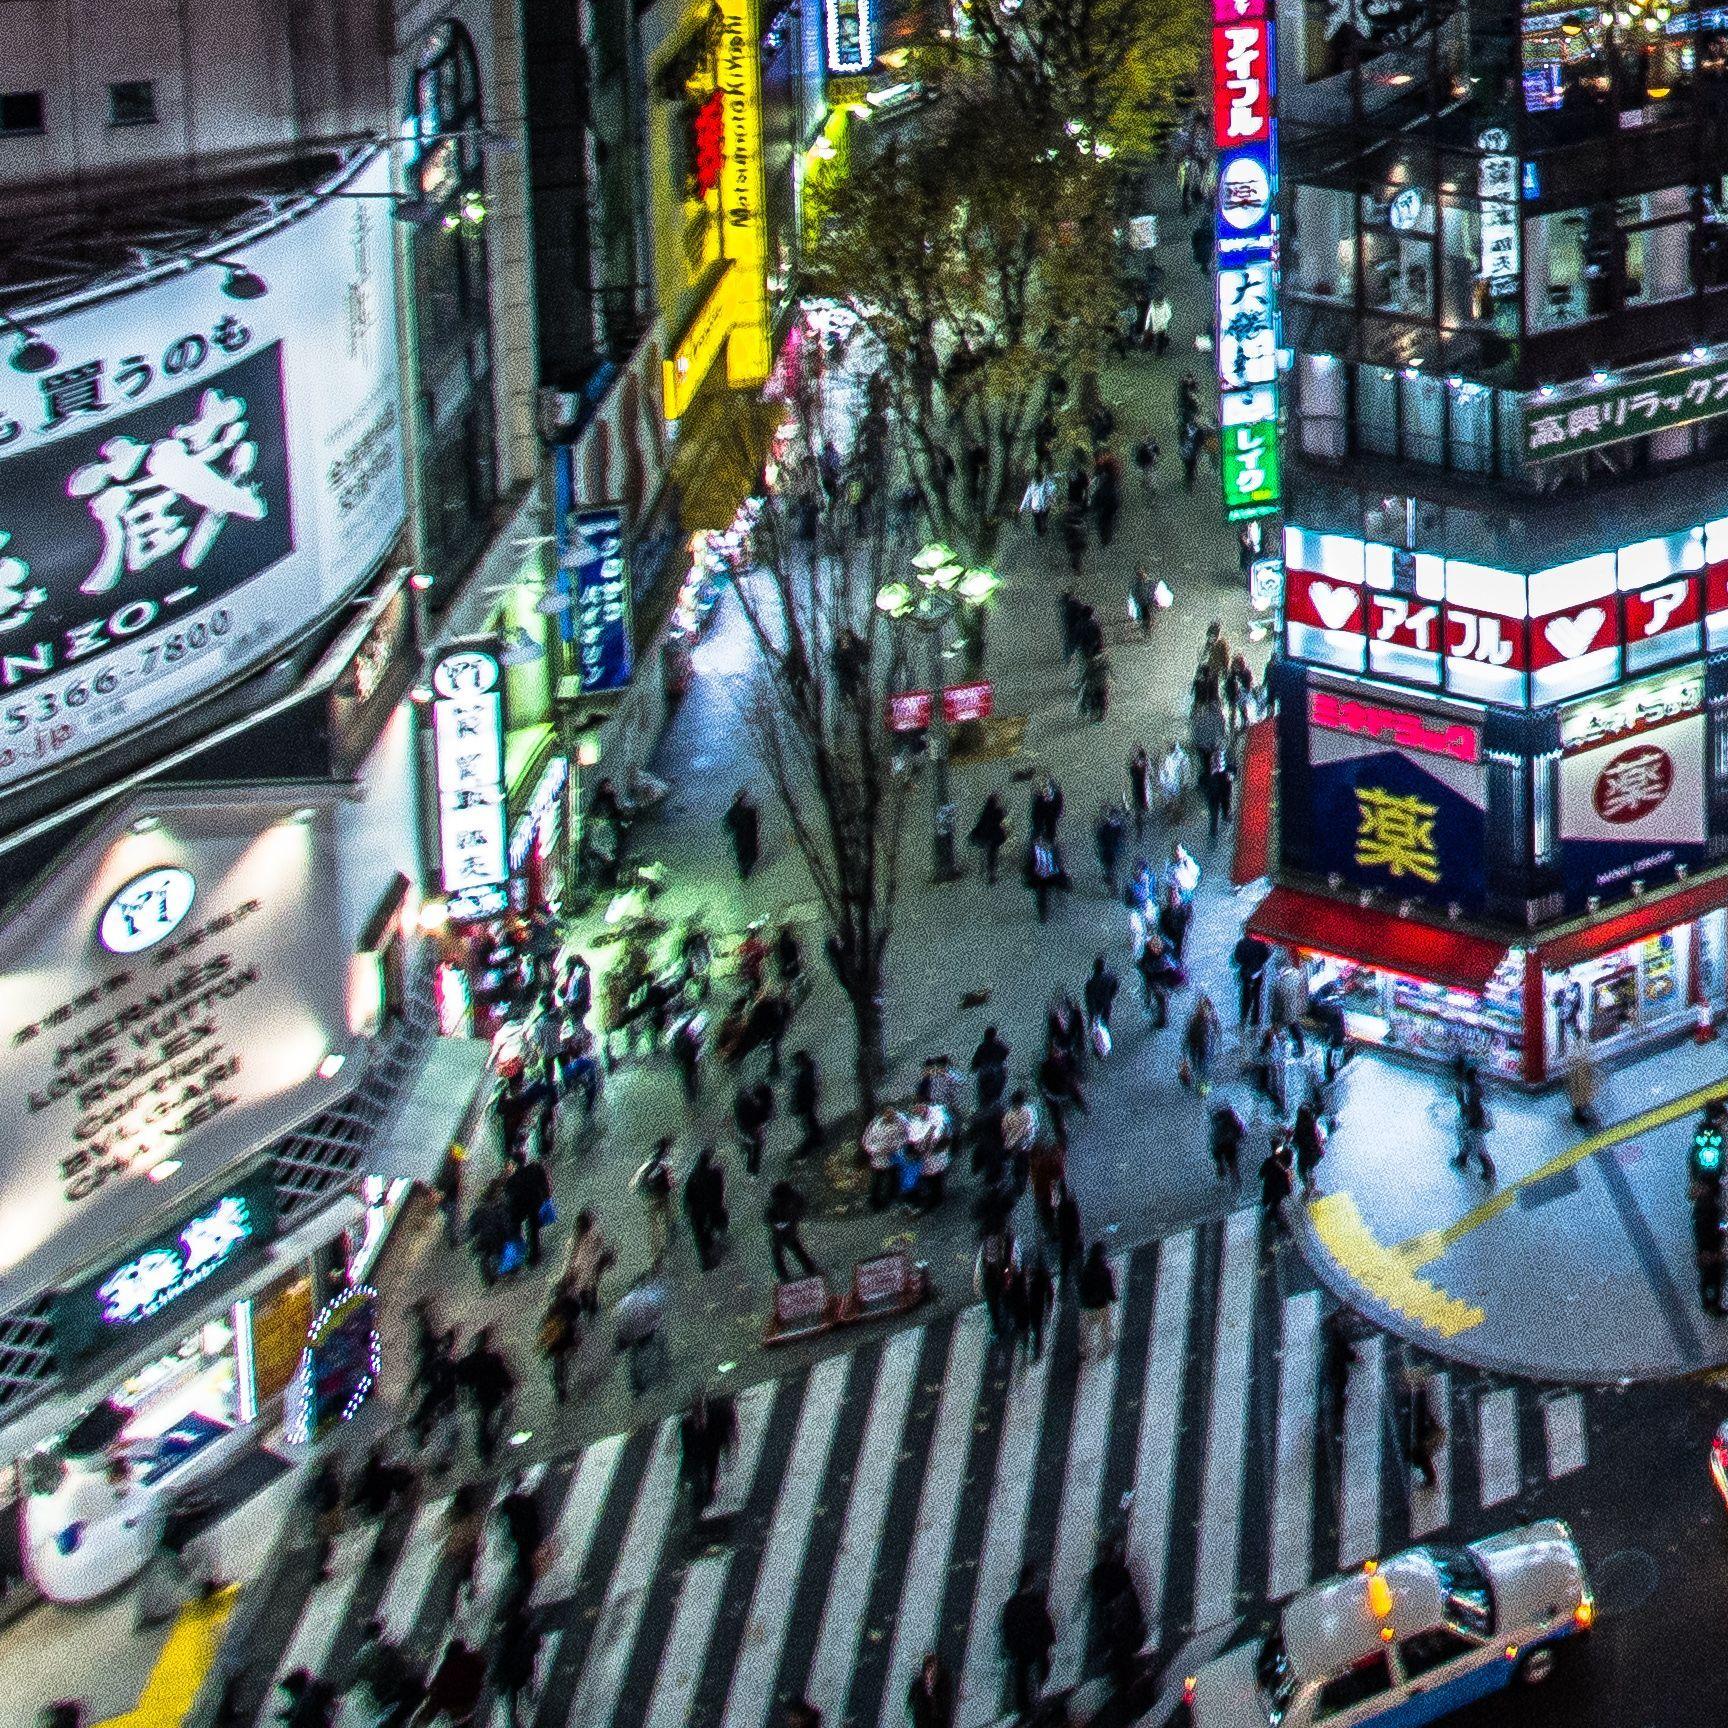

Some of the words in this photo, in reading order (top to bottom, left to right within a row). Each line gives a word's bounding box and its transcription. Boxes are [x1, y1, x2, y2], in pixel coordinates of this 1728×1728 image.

[1225, 25, 1263, 138] アイフル
[1237, 426, 1264, 493] レイク
[1372, 596, 1514, 666] アイフル
[1313, 694, 1479, 763] ミネドラッグ
[1603, 754, 1663, 817] 薬
[1354, 788, 1440, 884] 薬
